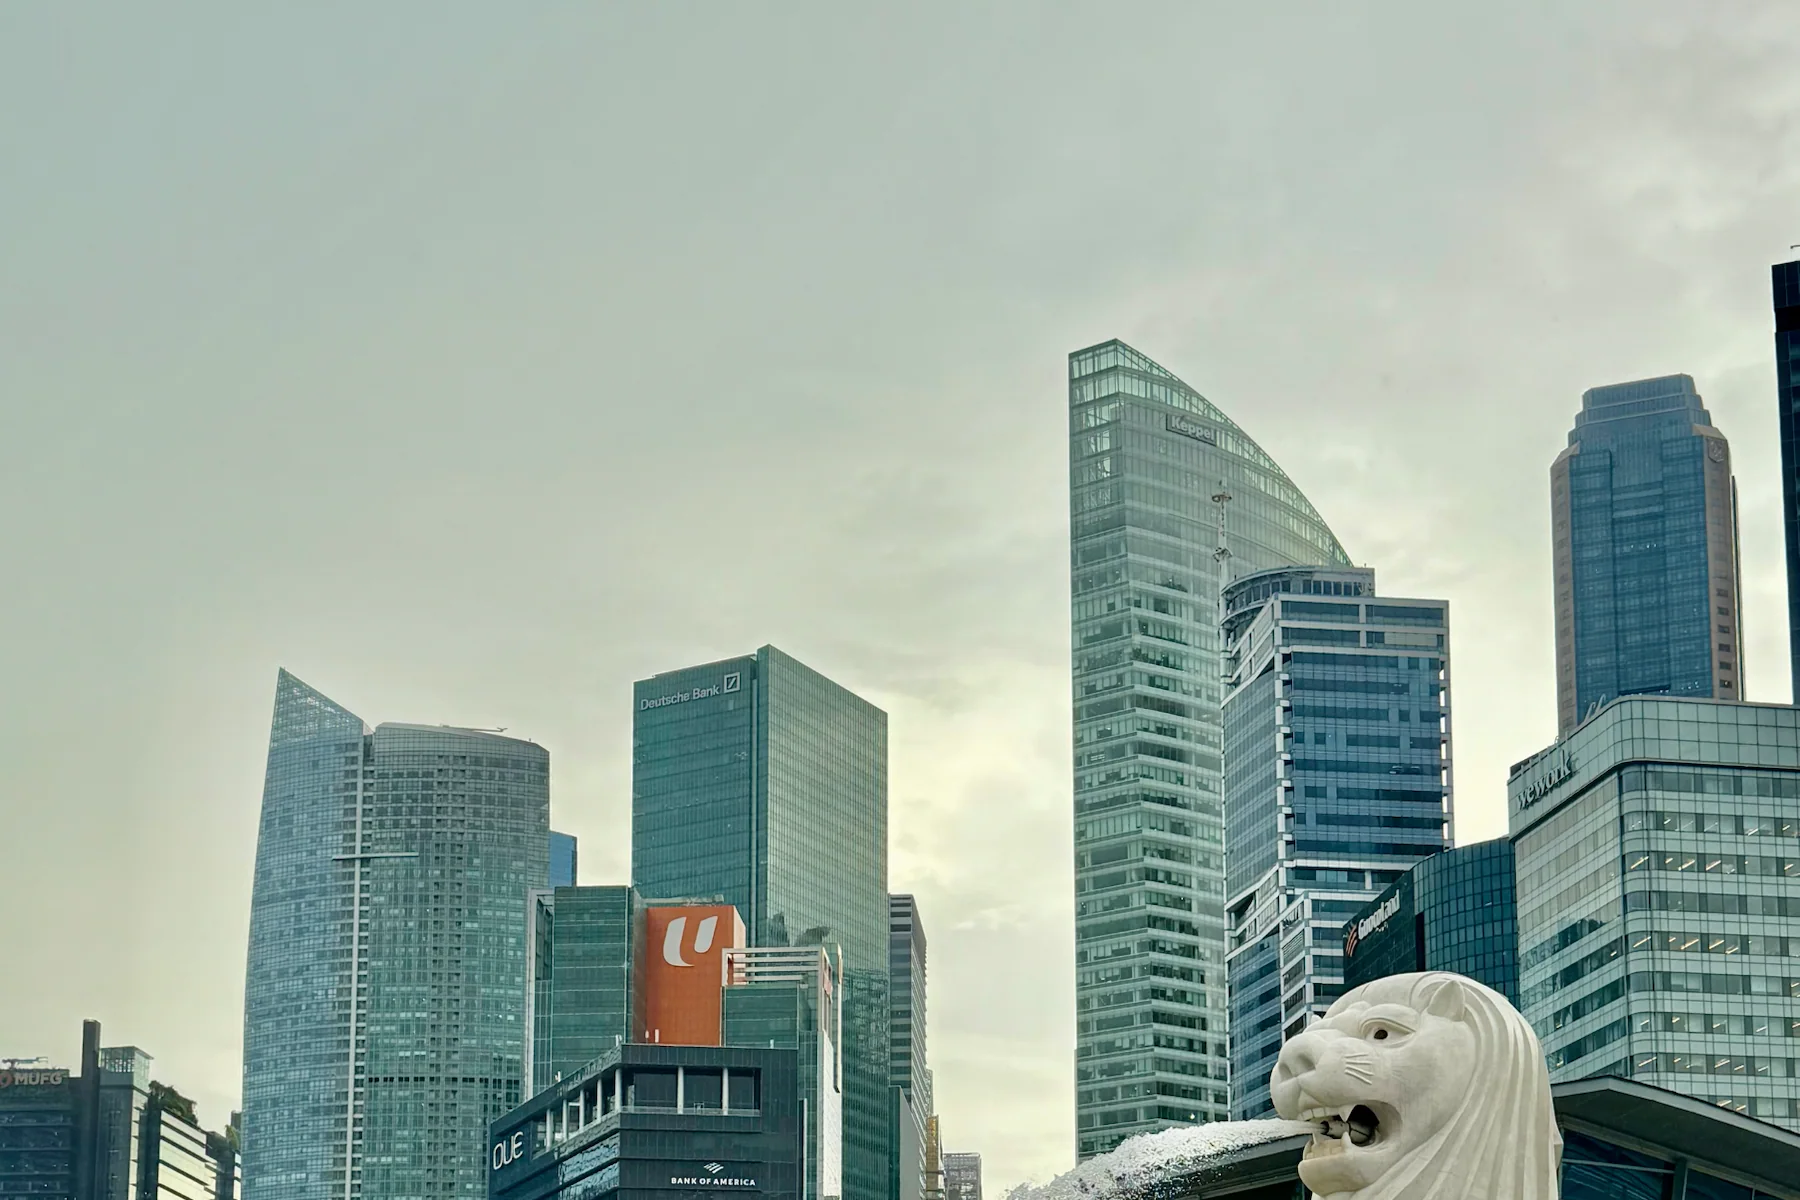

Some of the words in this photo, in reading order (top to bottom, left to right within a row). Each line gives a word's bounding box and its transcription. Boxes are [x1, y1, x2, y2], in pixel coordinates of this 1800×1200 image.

[1171, 415, 1215, 440] Keppel
[640, 692, 690, 711] Deutsche
[692, 684, 720, 700] Bank
[14, 1071, 63, 1086] MUFG
[671, 1177, 697, 1185] BANK
[713, 1178, 756, 1187] AMERICA
